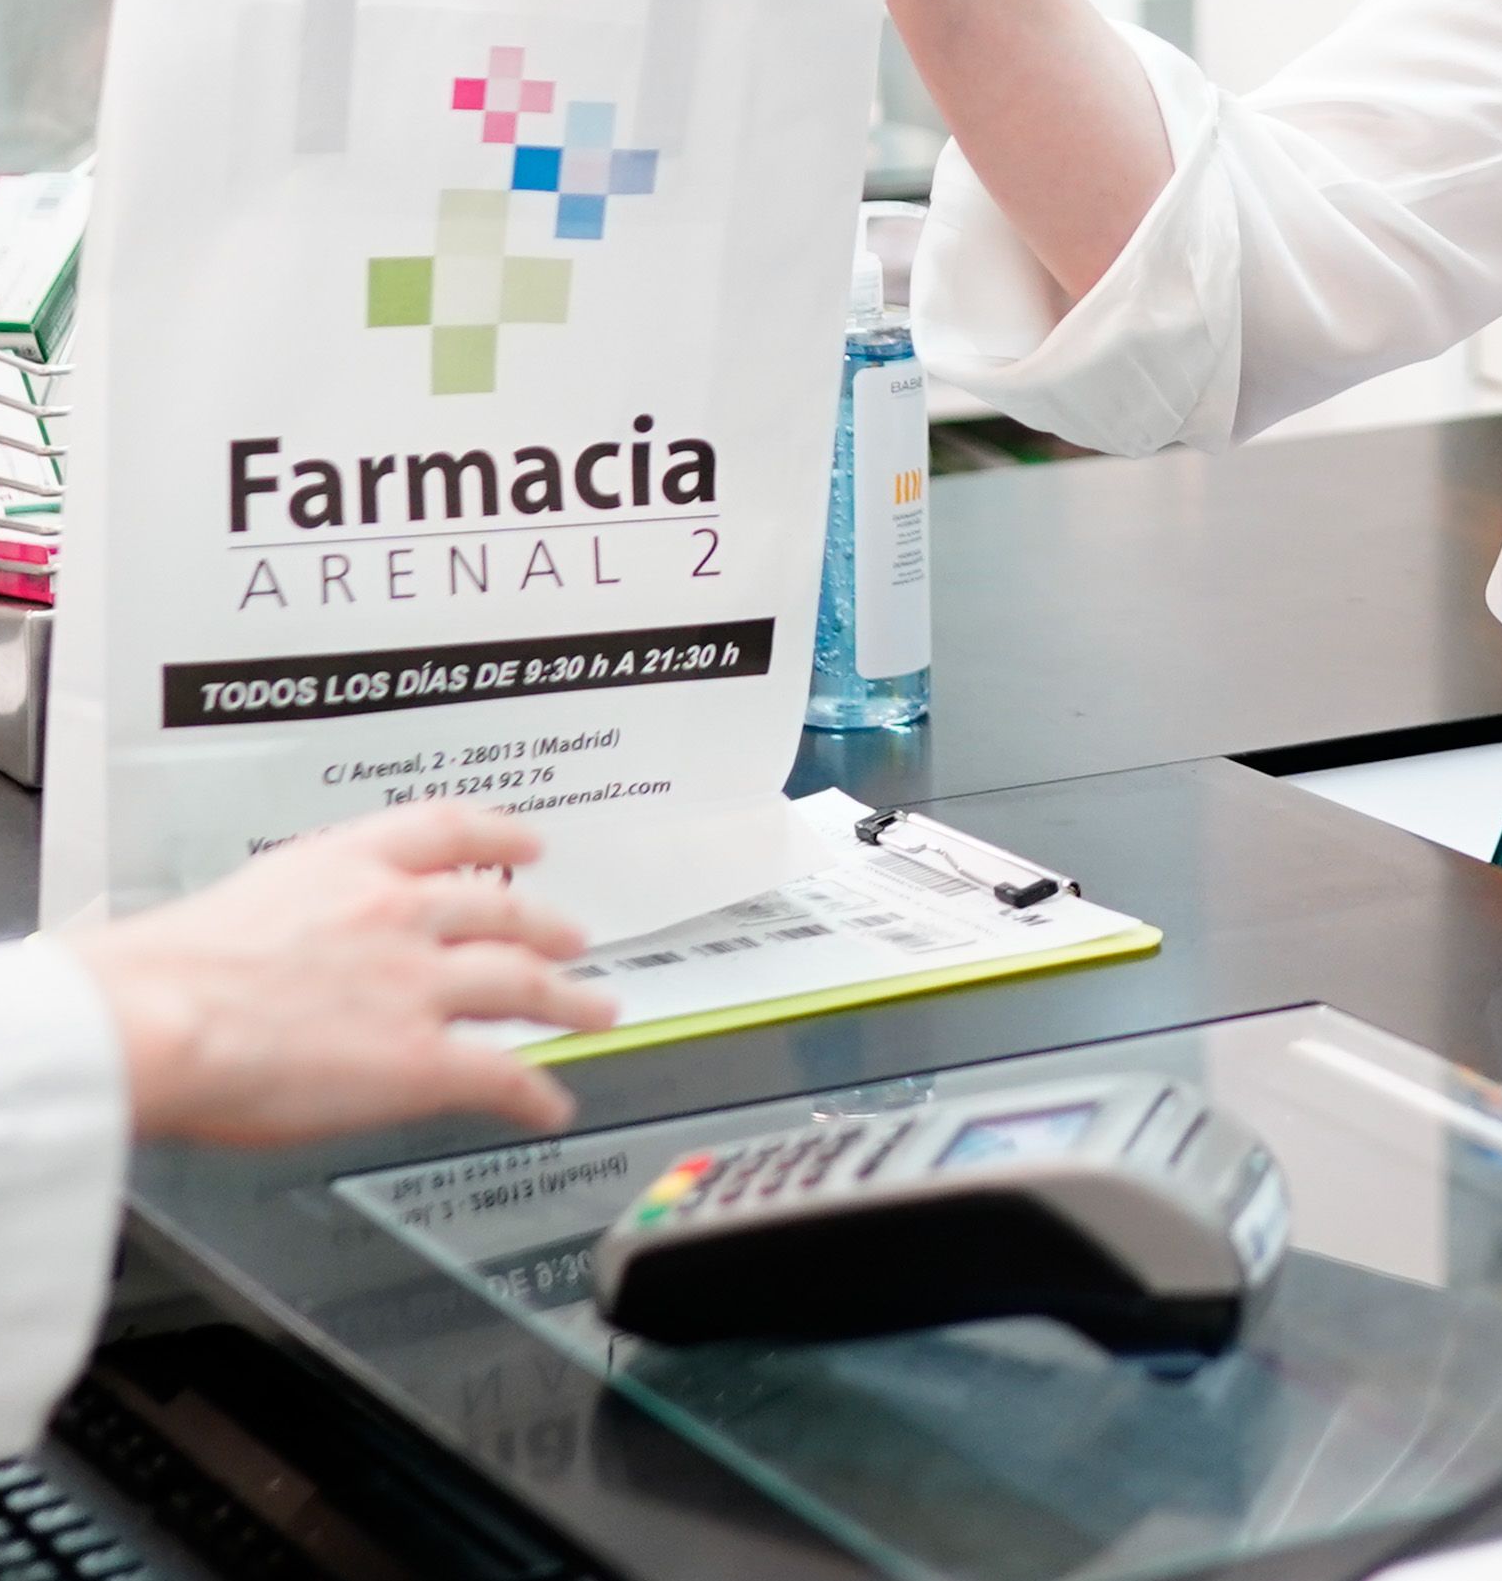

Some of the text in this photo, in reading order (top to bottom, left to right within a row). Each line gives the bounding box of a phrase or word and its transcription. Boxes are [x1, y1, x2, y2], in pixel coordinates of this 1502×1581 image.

[228, 413, 717, 533] Farmacia
[238, 528, 721, 611] ARENAL 2
[200, 641, 740, 712] TODOS LOS DÍAS DE 9:30 h A 21:30 h
[322, 763, 347, 785] C/
[350, 752, 426, 781] Arenal,
[432, 751, 446, 770] 2
[461, 741, 526, 766] 28013
[532, 727, 620, 759] (Madrid)
[384, 765, 555, 807] Tel. 91 524 92 76
